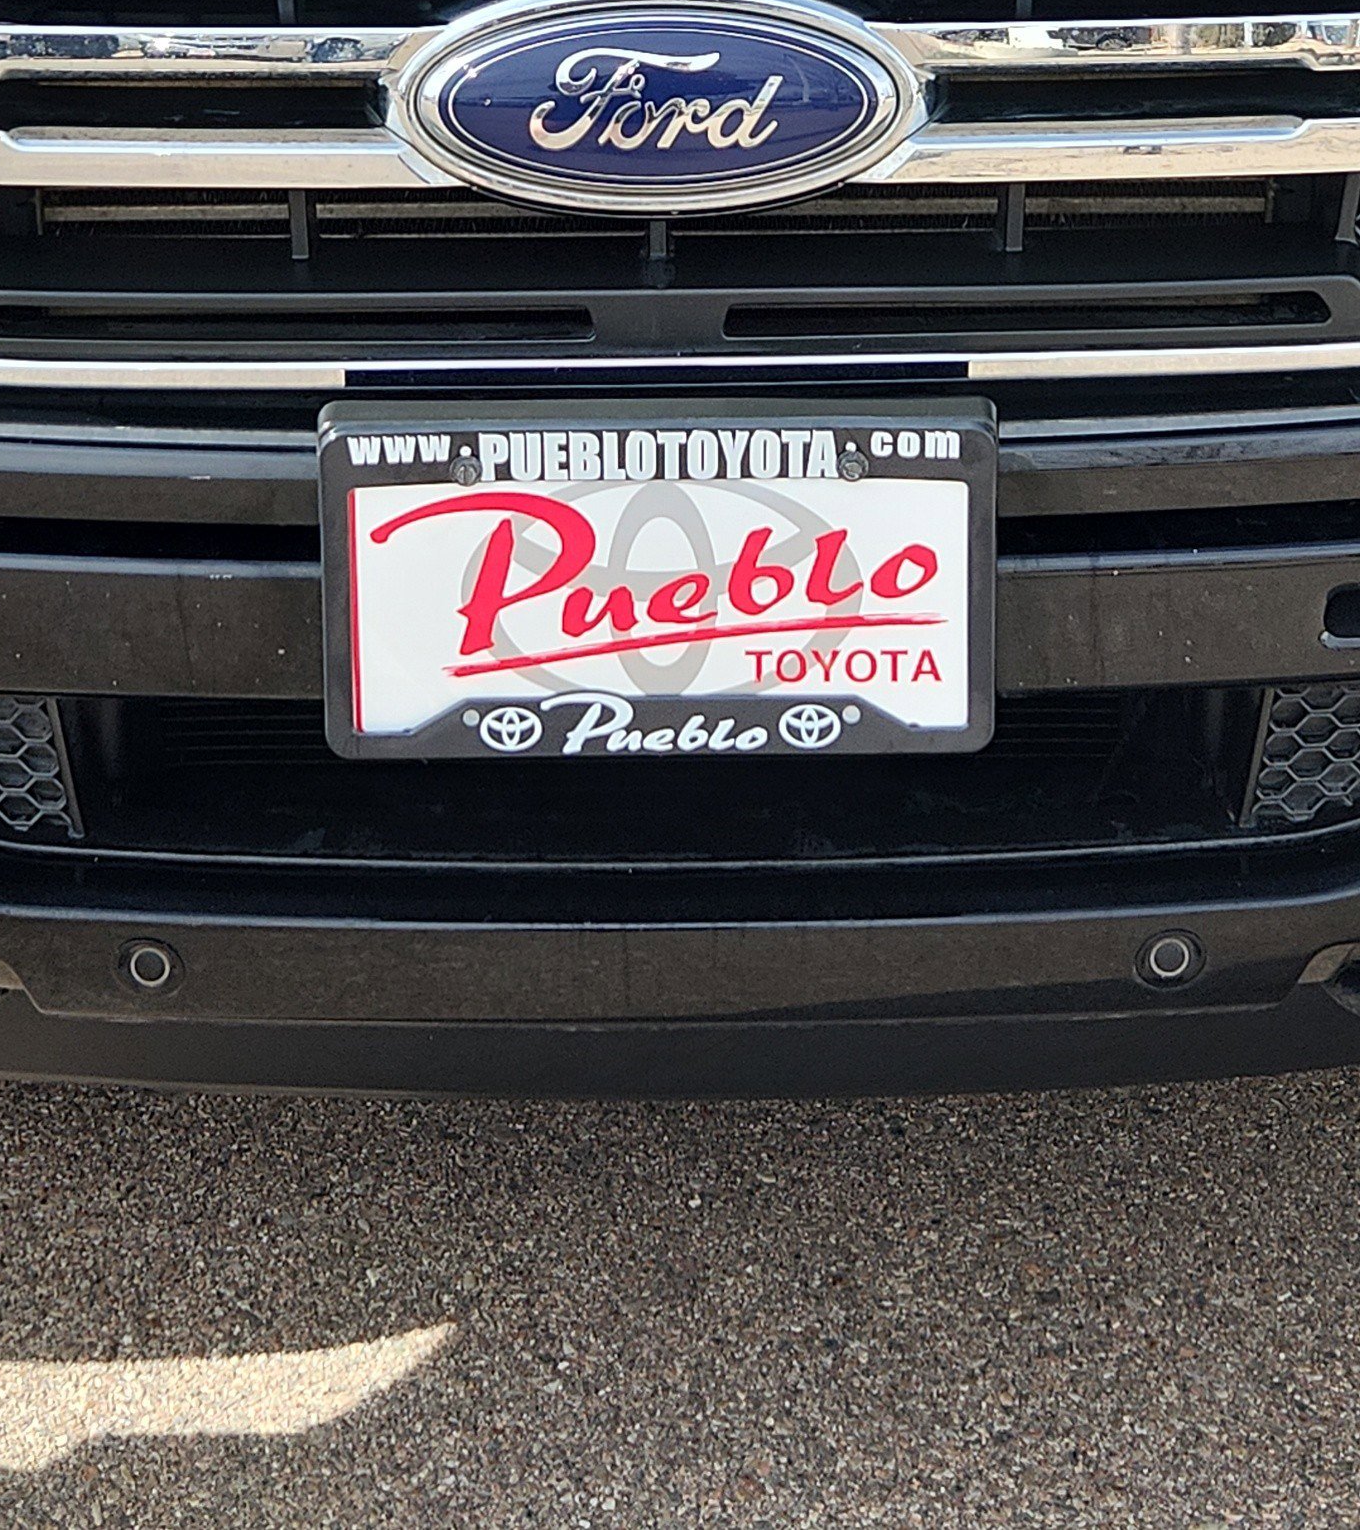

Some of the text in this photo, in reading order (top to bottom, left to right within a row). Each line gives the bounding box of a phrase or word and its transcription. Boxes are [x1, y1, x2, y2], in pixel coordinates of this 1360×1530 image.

[528, 47, 785, 151] Ford
[369, 491, 939, 655] Pueblo
[744, 649, 943, 683] TOYOTA
[541, 692, 770, 754] Pueblo
